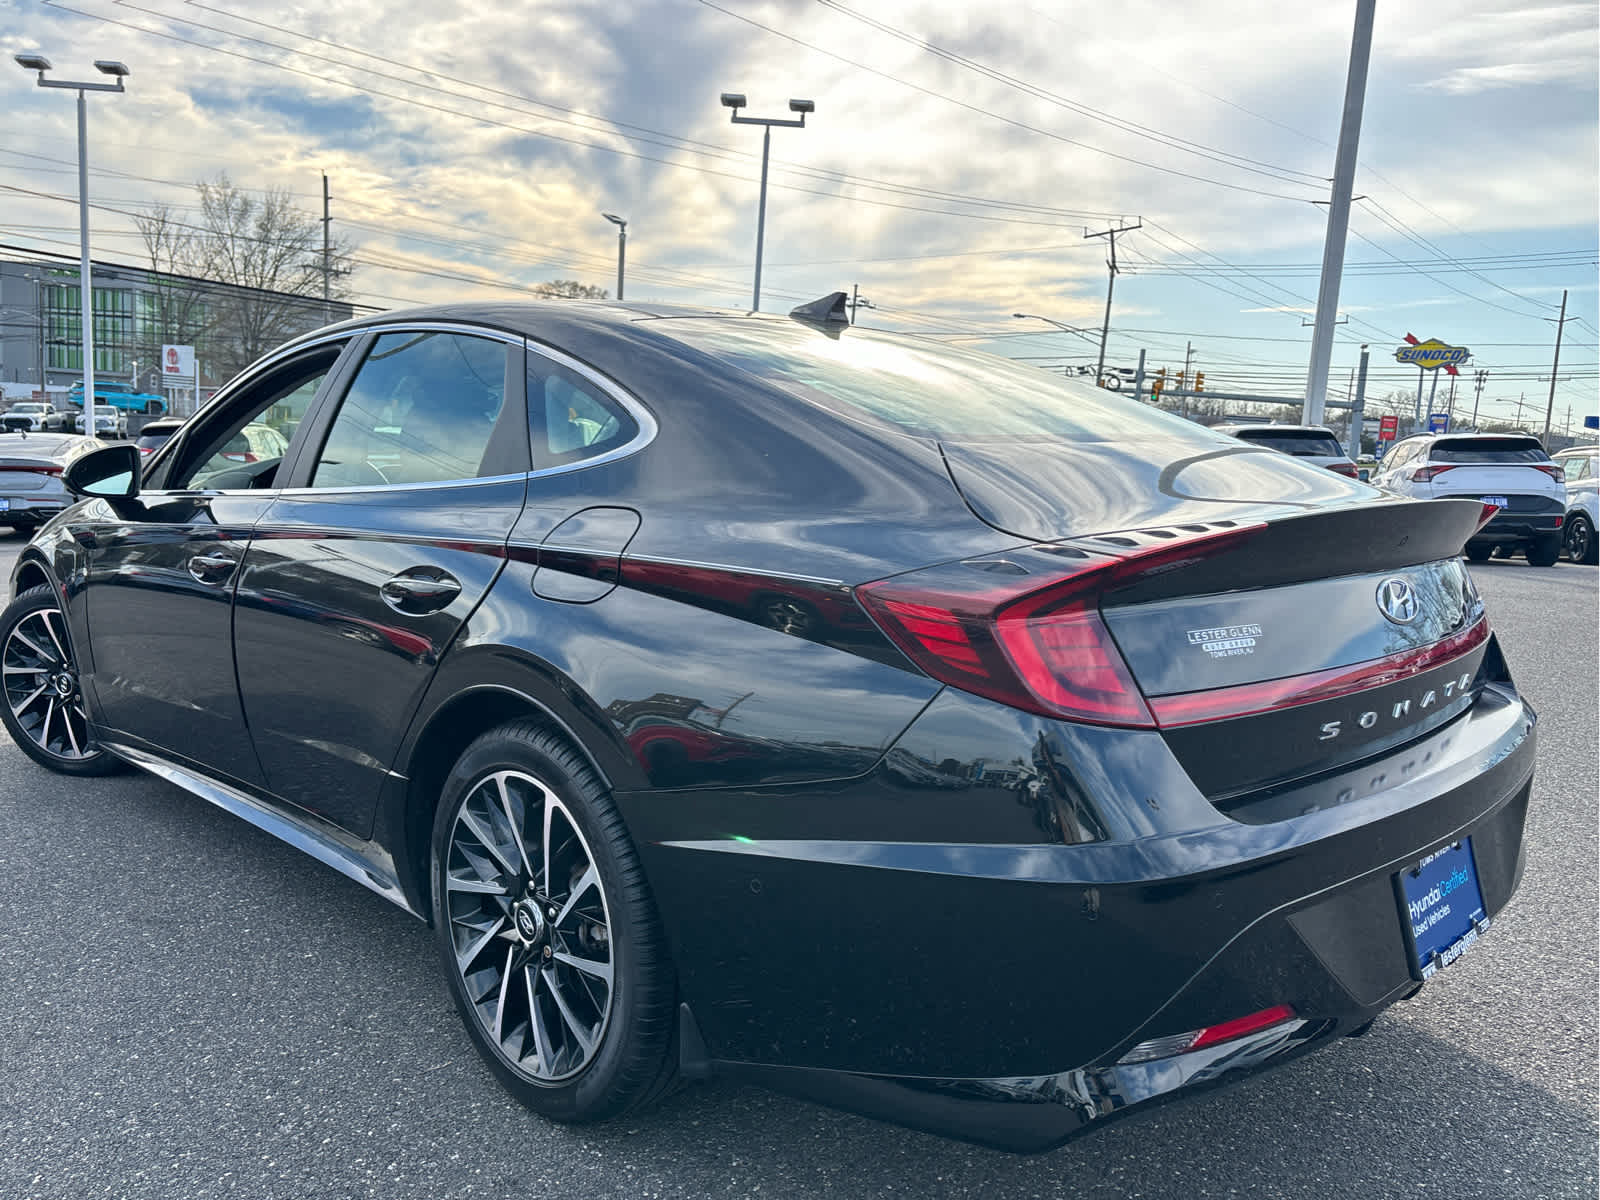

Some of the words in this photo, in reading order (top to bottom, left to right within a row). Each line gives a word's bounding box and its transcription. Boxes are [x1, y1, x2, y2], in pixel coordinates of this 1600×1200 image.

[1400, 350, 1462, 361] SUNOCO
[1187, 630, 1228, 643] LESTER
[1230, 626, 1263, 637] GLENN
[1204, 642, 1225, 650] AUTO
[1229, 640, 1254, 648] GROUP
[1209, 650, 1228, 658] TOMS
[1317, 672, 1472, 742] SONATA
[1412, 916, 1428, 938] Used
[1428, 904, 1451, 927] Vehicles
